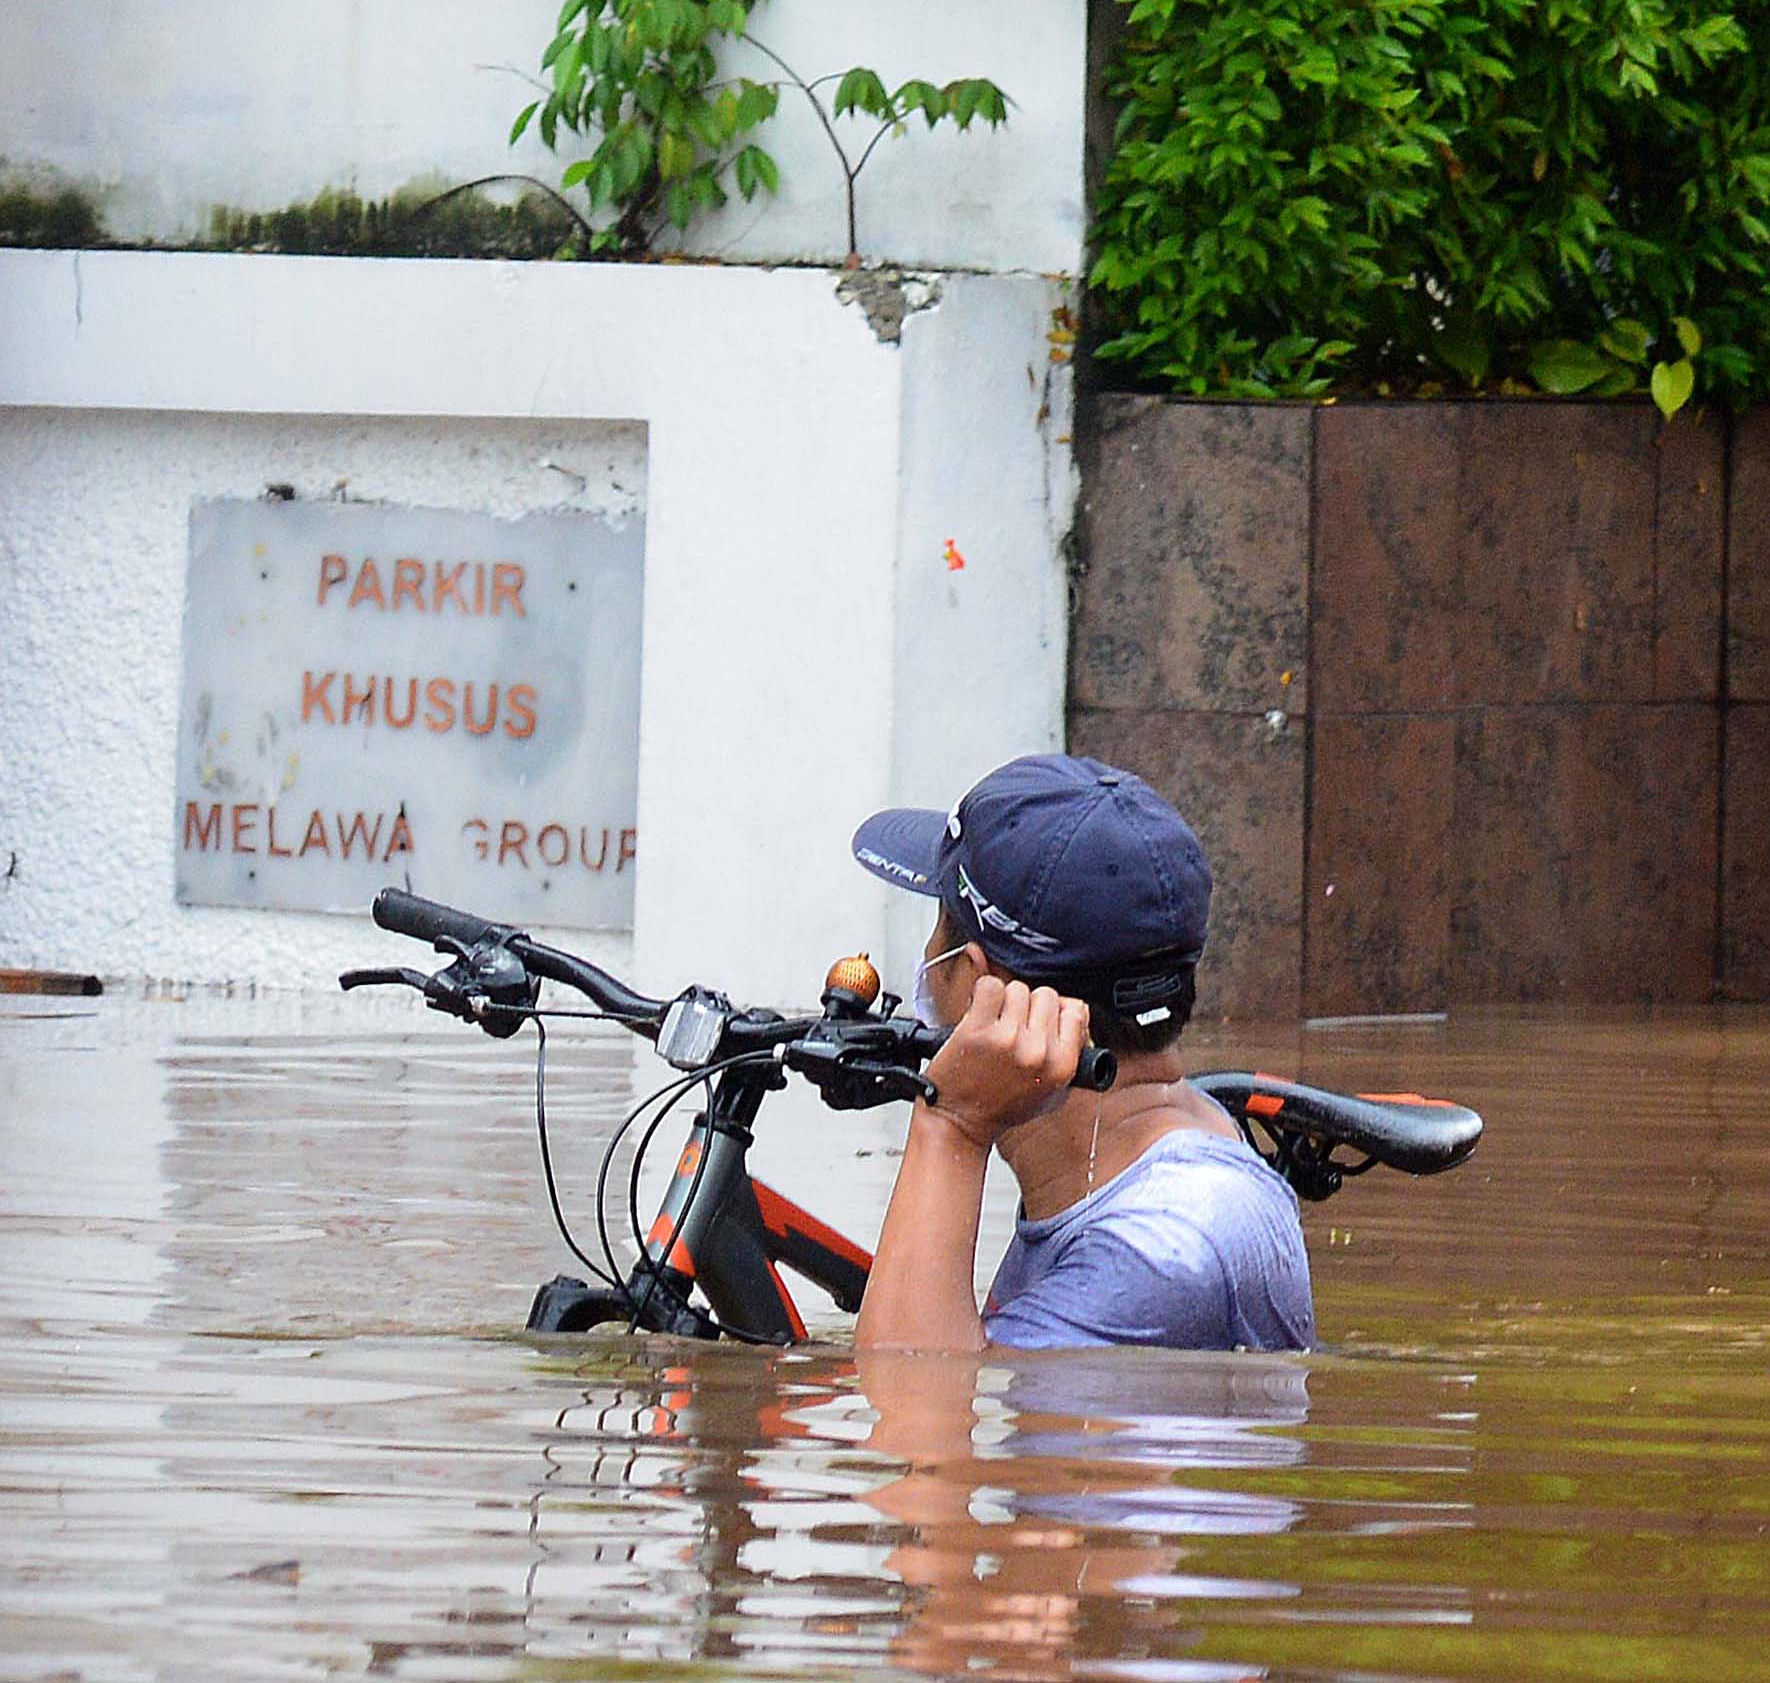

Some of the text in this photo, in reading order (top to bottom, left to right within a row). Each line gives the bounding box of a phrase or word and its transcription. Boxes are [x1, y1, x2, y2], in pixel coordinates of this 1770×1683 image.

[316, 554, 527, 618] PARKIR
[300, 670, 538, 739] KHUSUS
[182, 801, 417, 864] MELAWA
